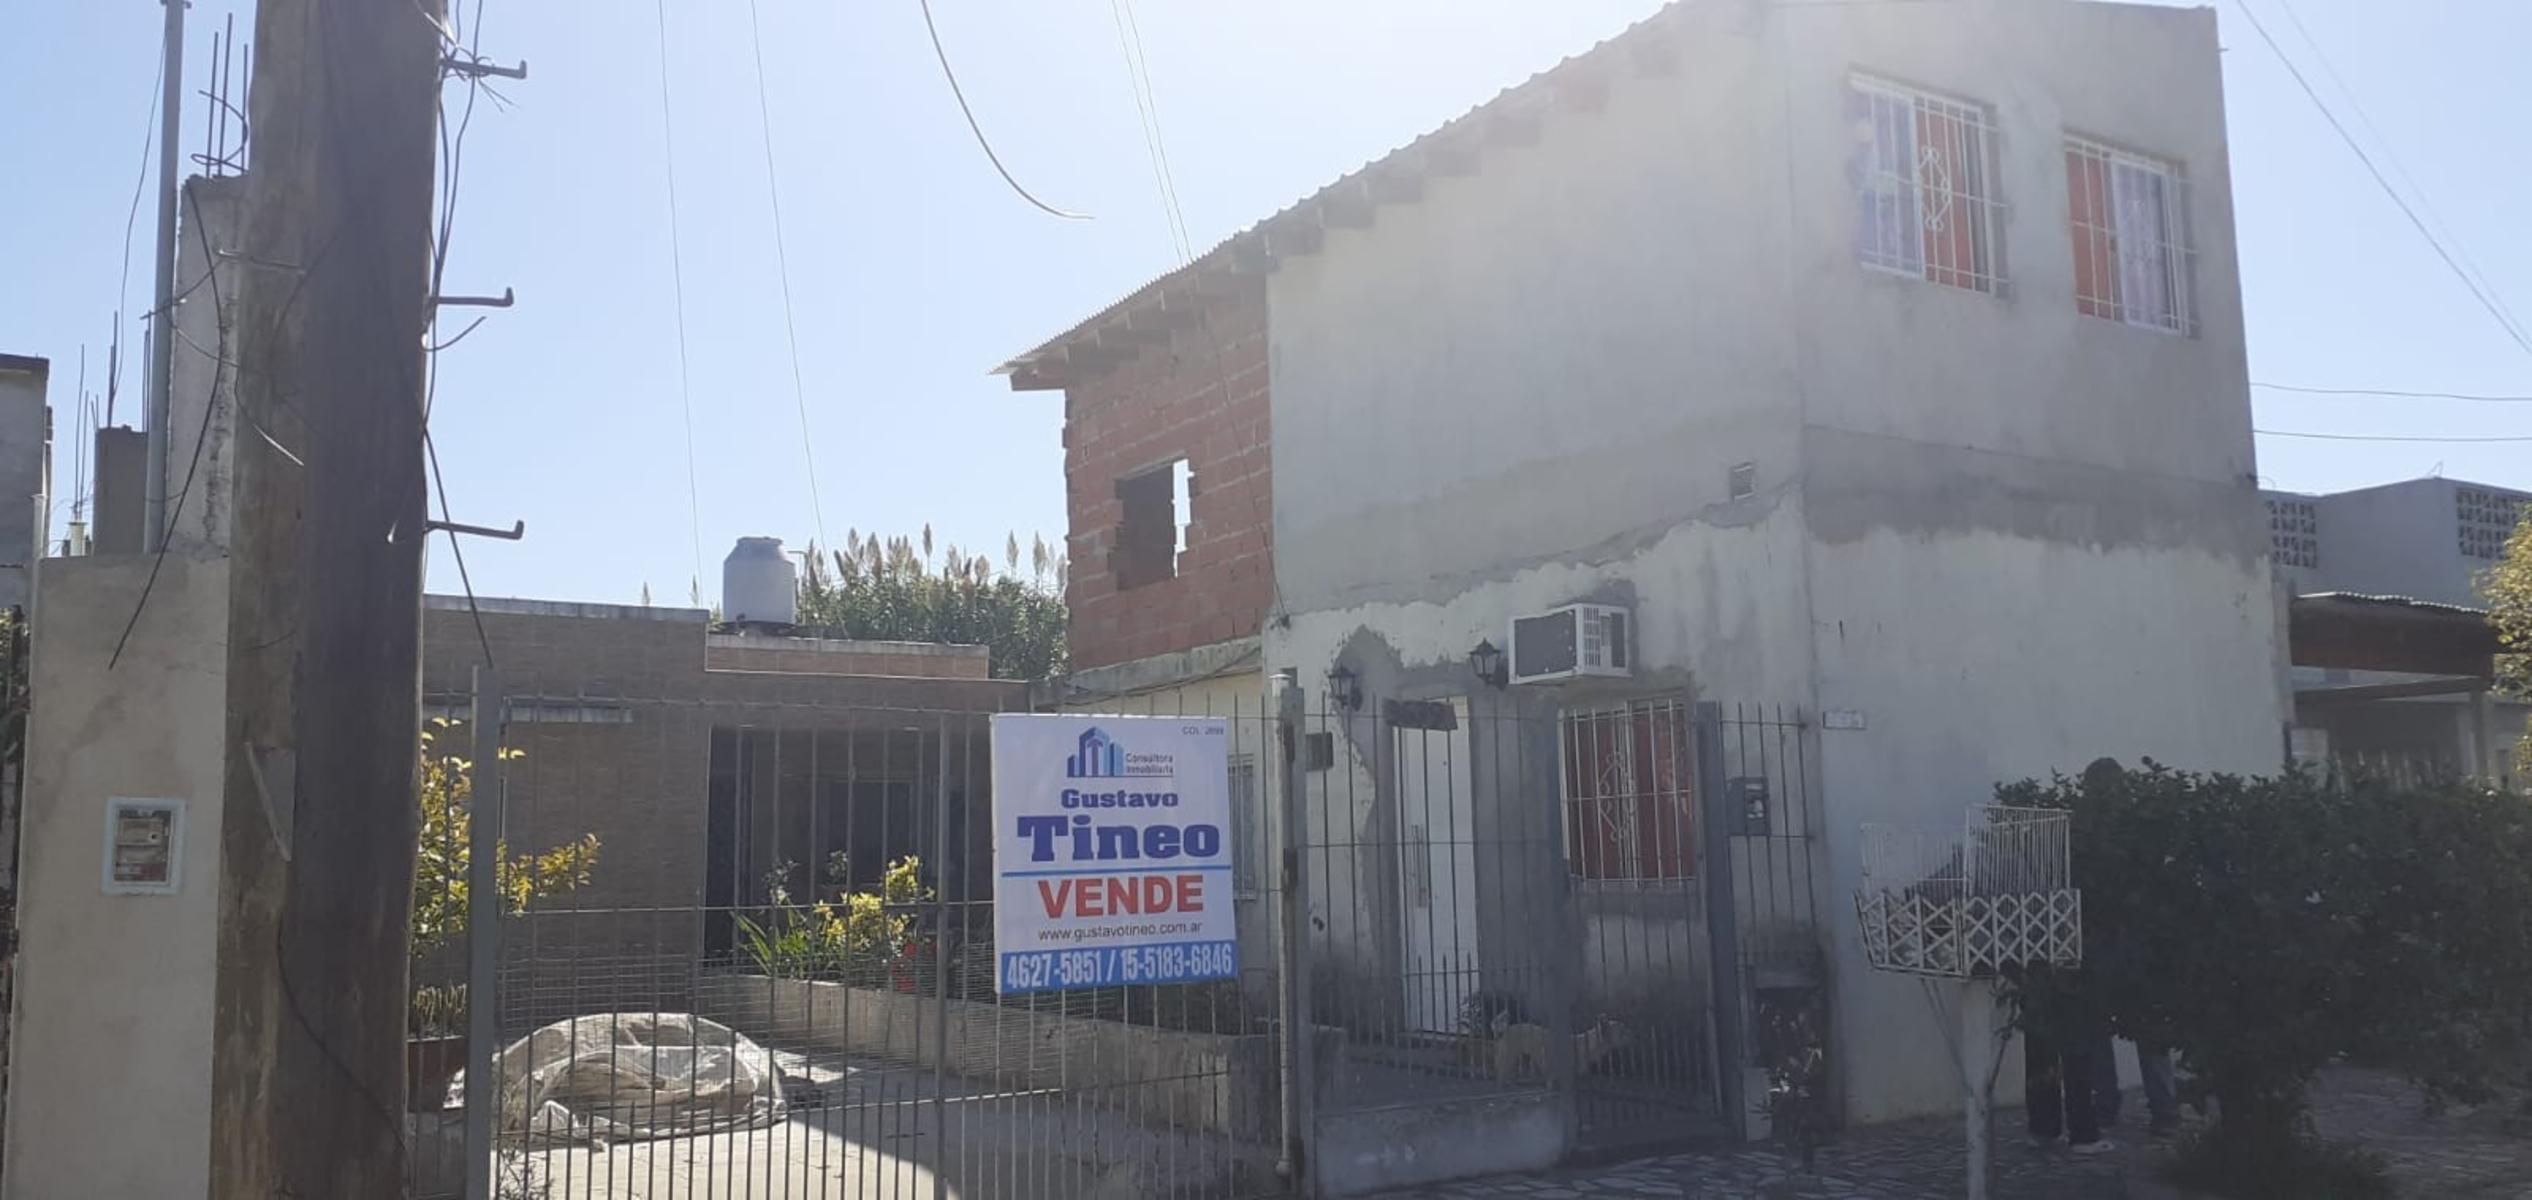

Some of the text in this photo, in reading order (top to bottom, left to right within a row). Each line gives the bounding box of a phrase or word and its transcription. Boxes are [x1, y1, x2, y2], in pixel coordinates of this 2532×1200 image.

[1126, 753, 1174, 764] Consultora
[1126, 764, 1174, 774] Inmobiliaria
[1061, 788, 1179, 809] Gustavo
[1017, 814, 1220, 862] Tineo
[1038, 874, 1204, 919] VENDE
[1038, 922, 1203, 942] www.gustavotineo.com.ar
[1007, 943, 1232, 989] 4627-5851 / 15-5183-6846
